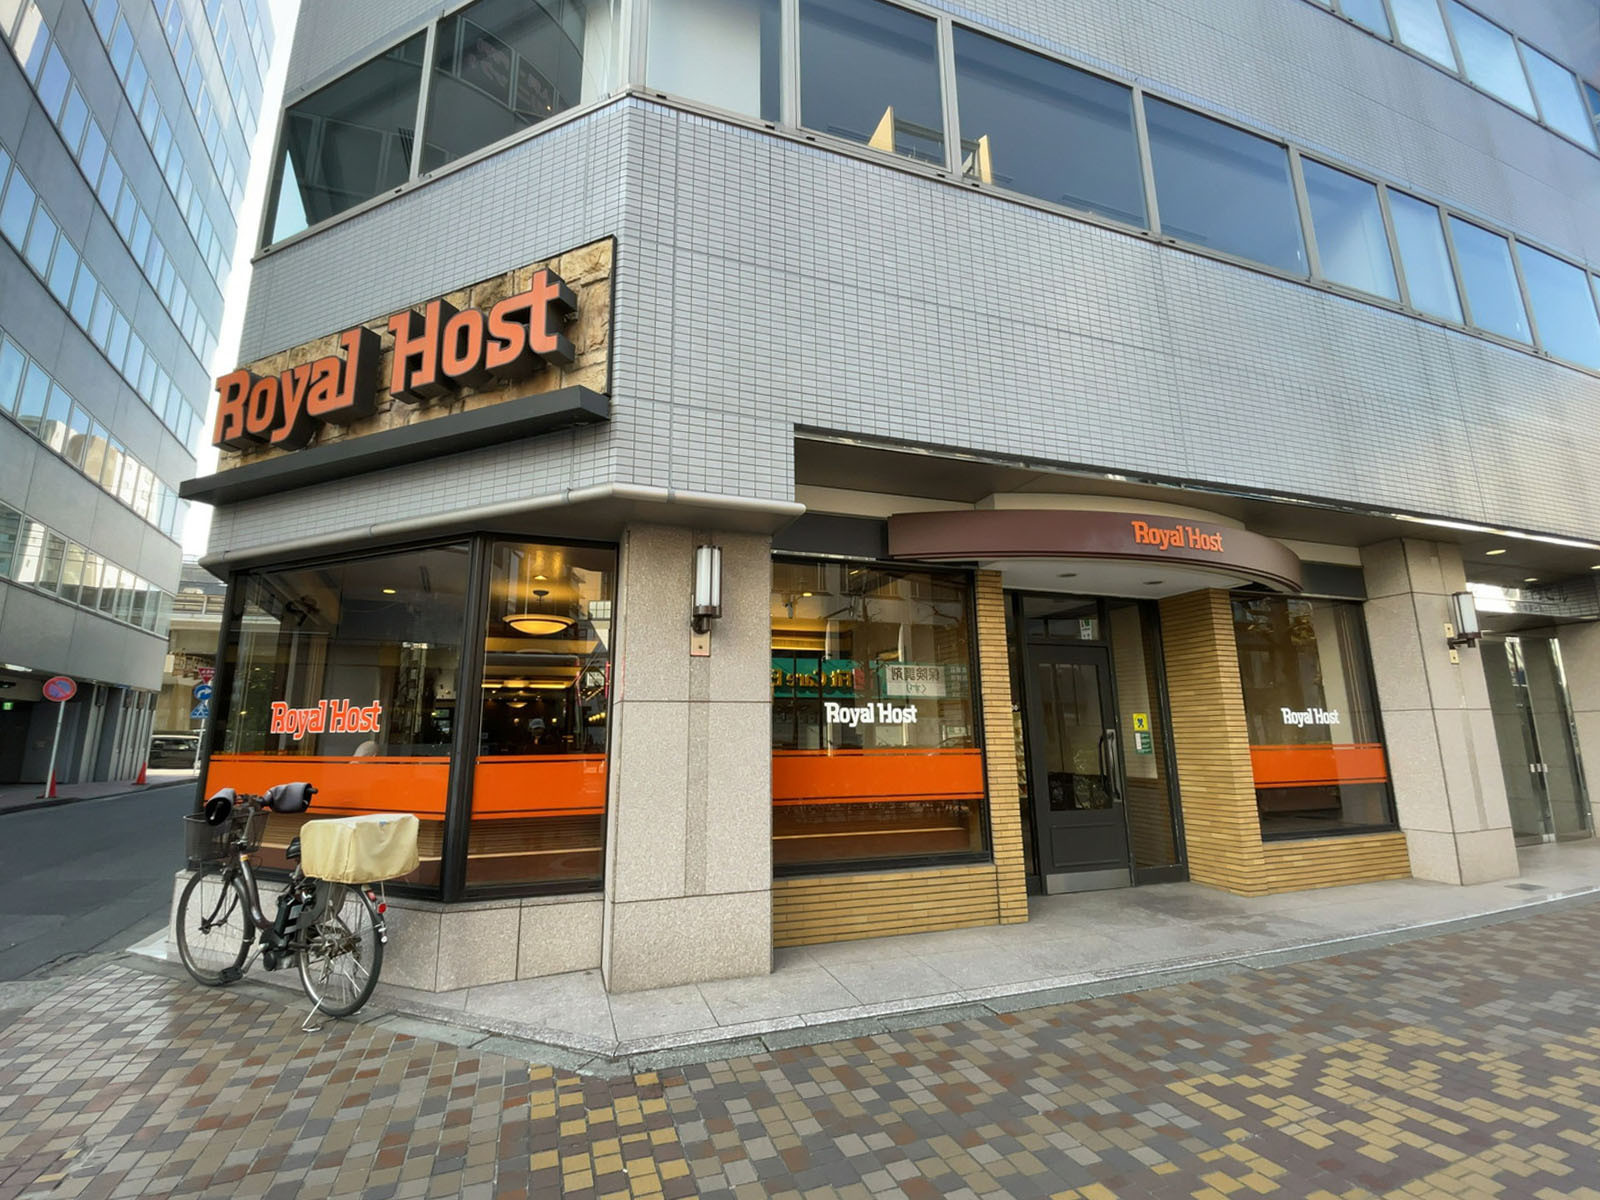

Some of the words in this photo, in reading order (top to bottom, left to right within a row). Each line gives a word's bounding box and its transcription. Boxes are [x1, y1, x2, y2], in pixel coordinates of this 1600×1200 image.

[212, 326, 368, 446] Royal
[388, 268, 567, 399] Host
[1131, 520, 1184, 551] Royal
[1185, 526, 1224, 552] Host
[270, 700, 328, 740] Royal
[329, 699, 382, 733] Host
[824, 702, 874, 728] Royal
[877, 702, 918, 724] Host
[1280, 707, 1314, 728] Royal
[1313, 707, 1340, 725] Host
